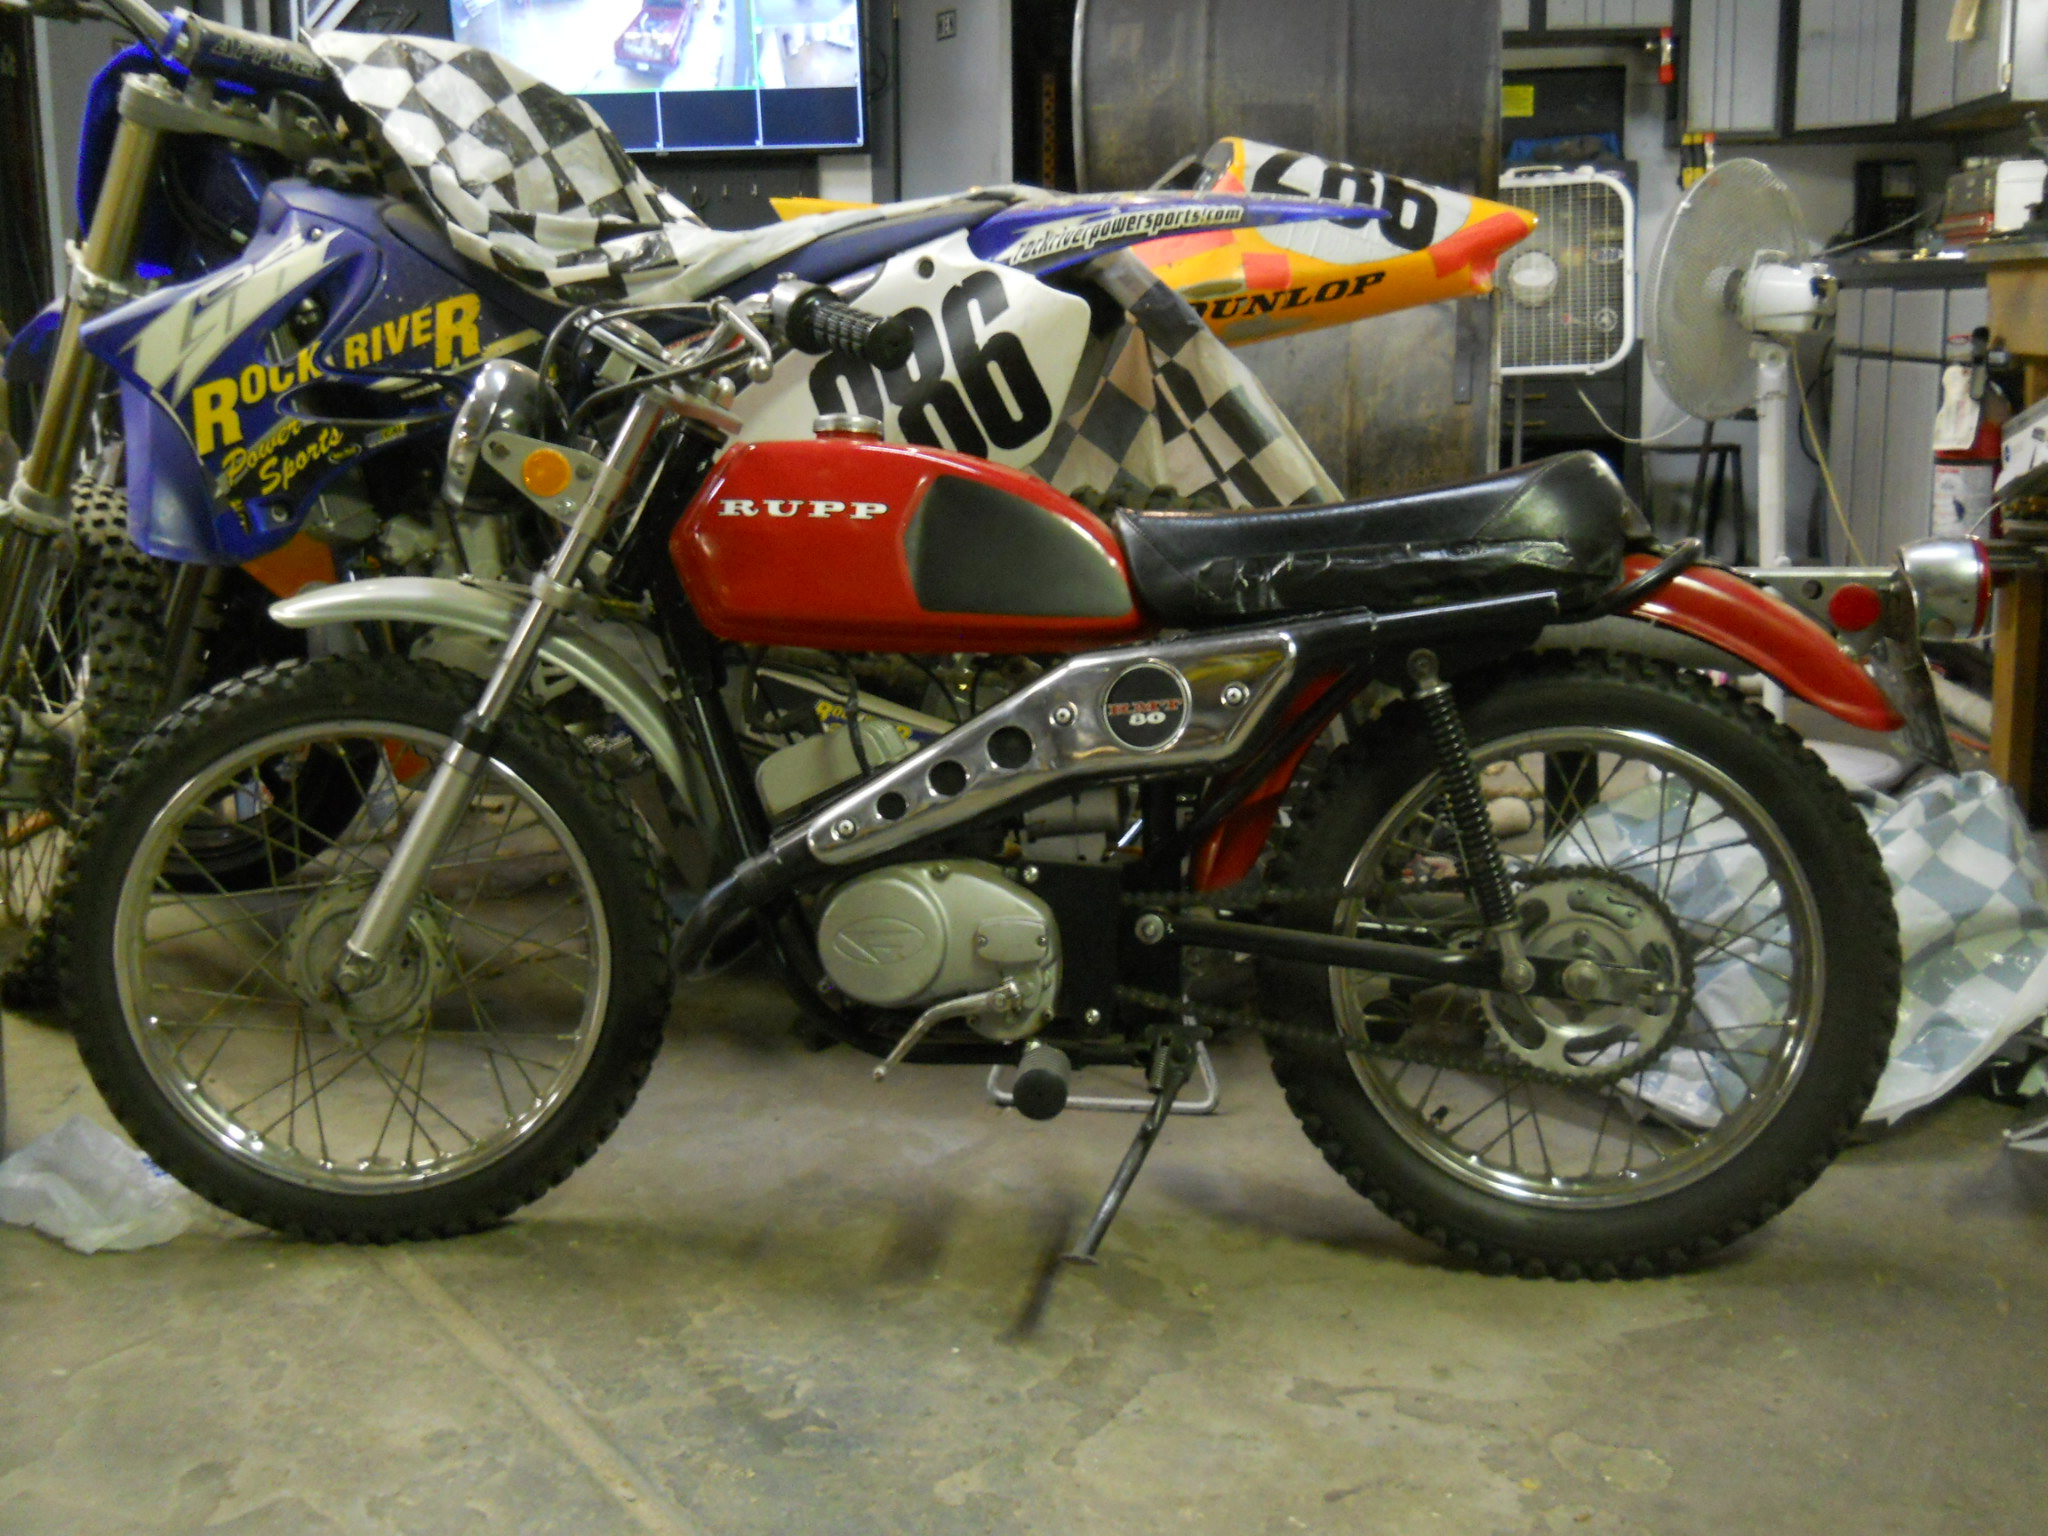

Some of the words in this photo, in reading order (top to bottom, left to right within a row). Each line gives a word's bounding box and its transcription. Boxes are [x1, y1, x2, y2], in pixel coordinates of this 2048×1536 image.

[192, 340, 324, 456] ROCK
[344, 293, 481, 370] RIVER
[220, 419, 302, 488] Power
[257, 427, 345, 496] Sports
[717, 498, 889, 521] RUPP
